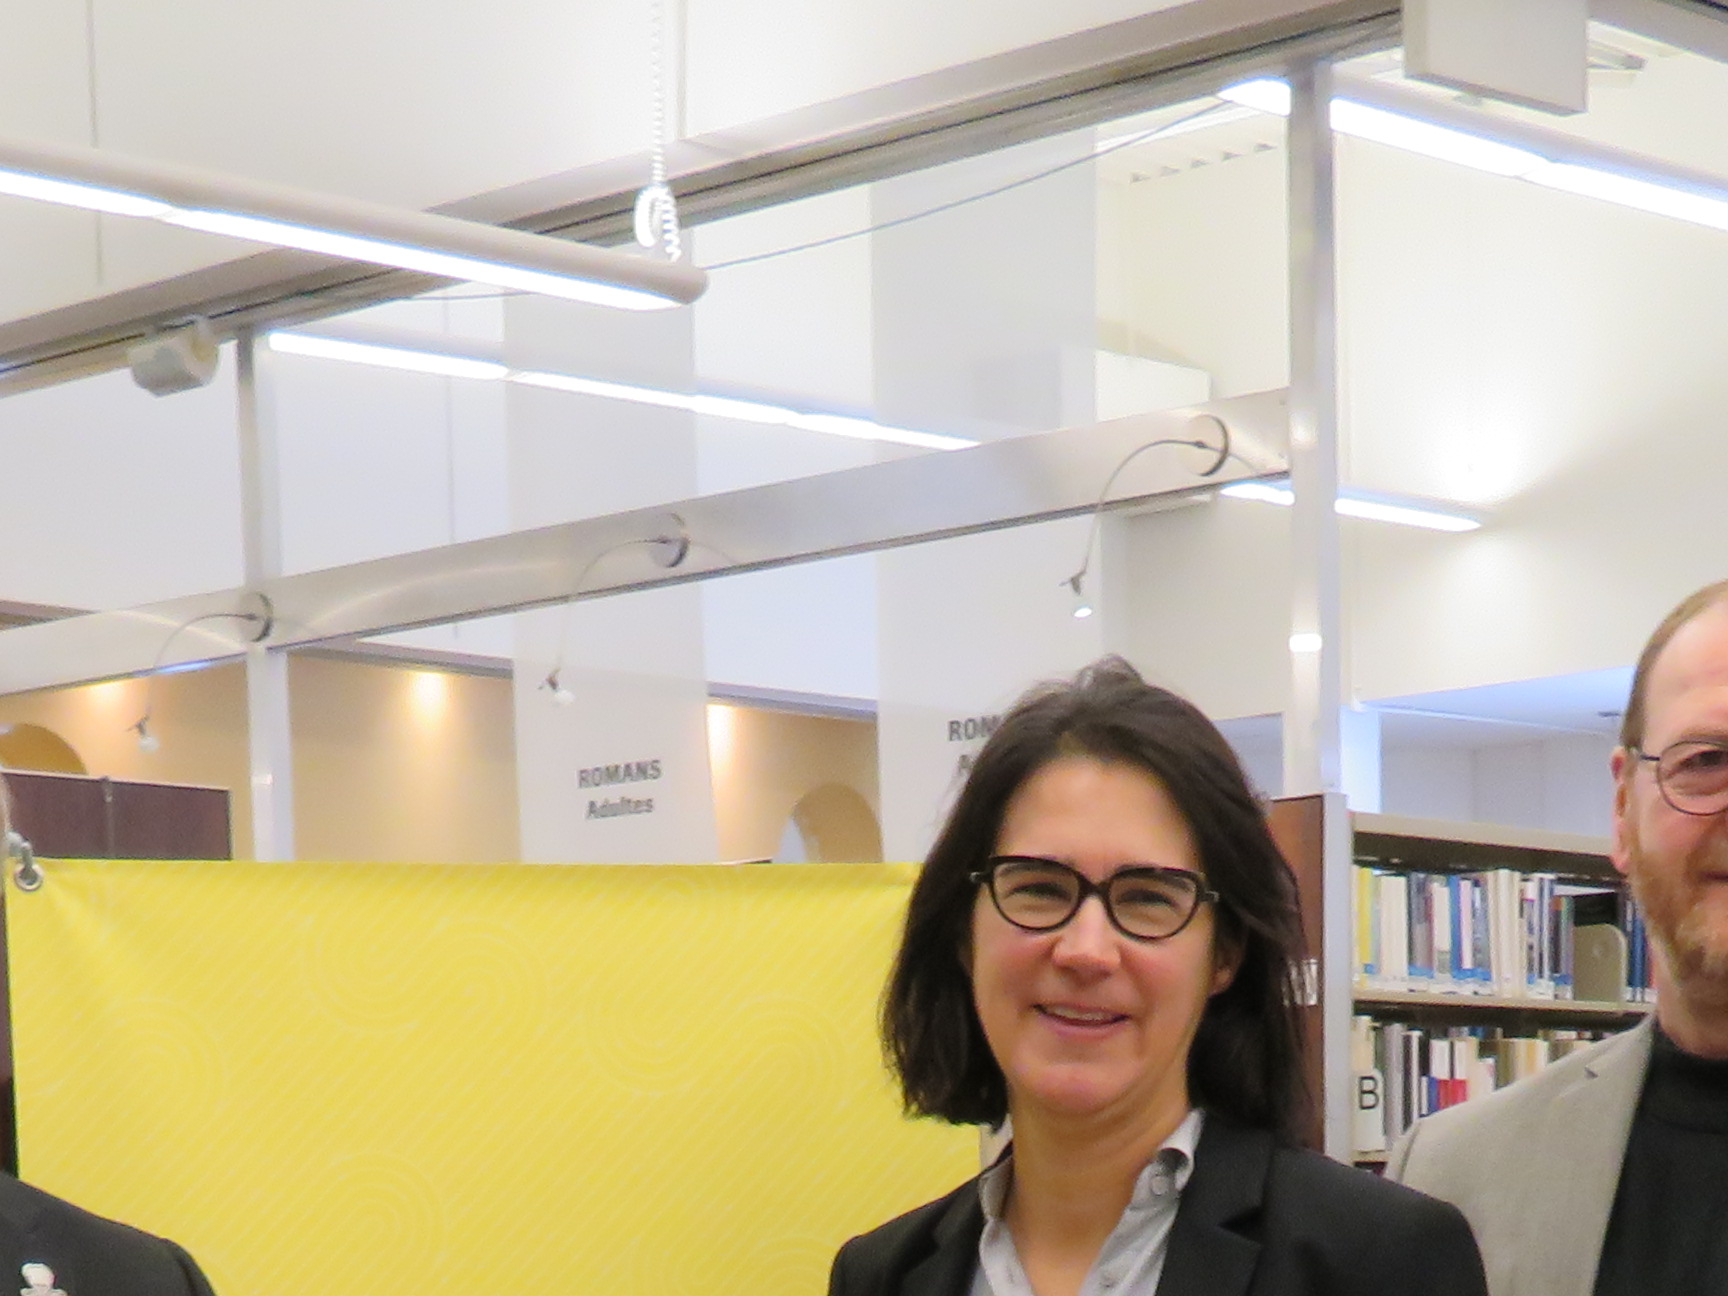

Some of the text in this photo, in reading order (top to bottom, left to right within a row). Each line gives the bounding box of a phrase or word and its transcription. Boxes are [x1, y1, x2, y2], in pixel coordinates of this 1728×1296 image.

[949, 716, 1006, 741] ROM
[579, 759, 661, 788] ROMANS
[1359, 1076, 1379, 1109] B
